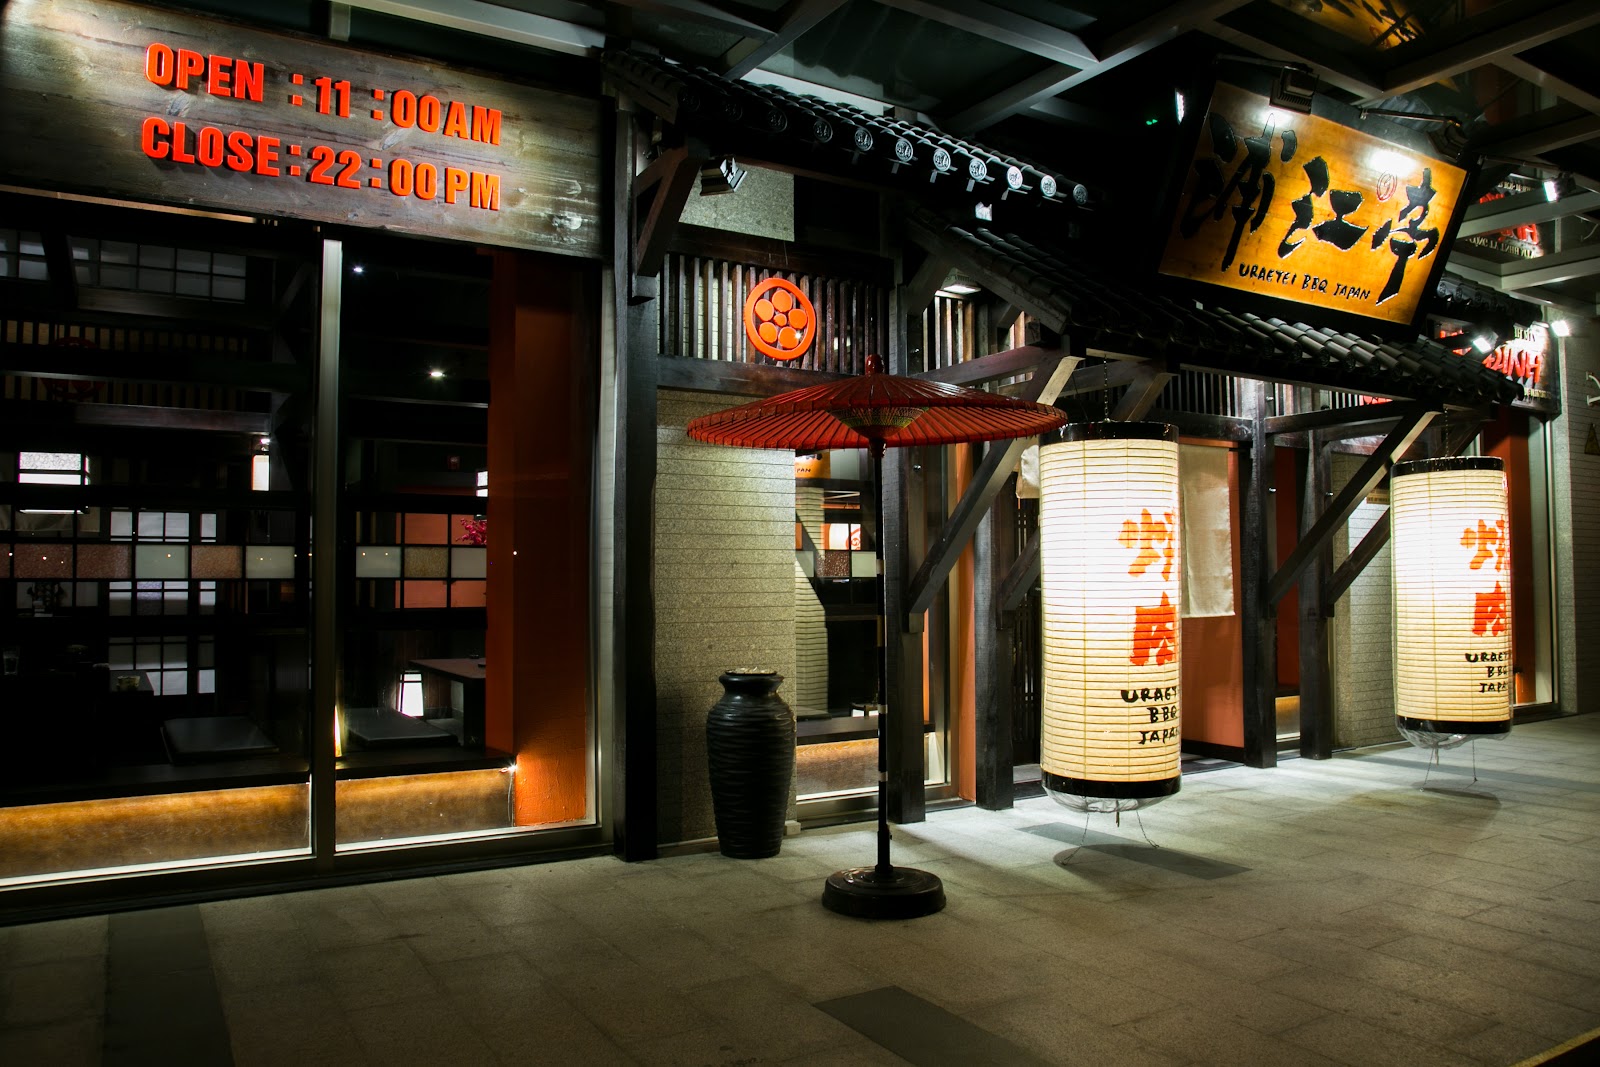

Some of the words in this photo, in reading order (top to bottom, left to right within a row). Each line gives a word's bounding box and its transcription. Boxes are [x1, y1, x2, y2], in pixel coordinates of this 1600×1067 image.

[145, 42, 265, 102] OPEN
[1301, 273, 1328, 293] BBQ
[1333, 283, 1371, 300] JAPAN
[1147, 705, 1178, 724] BBQ
